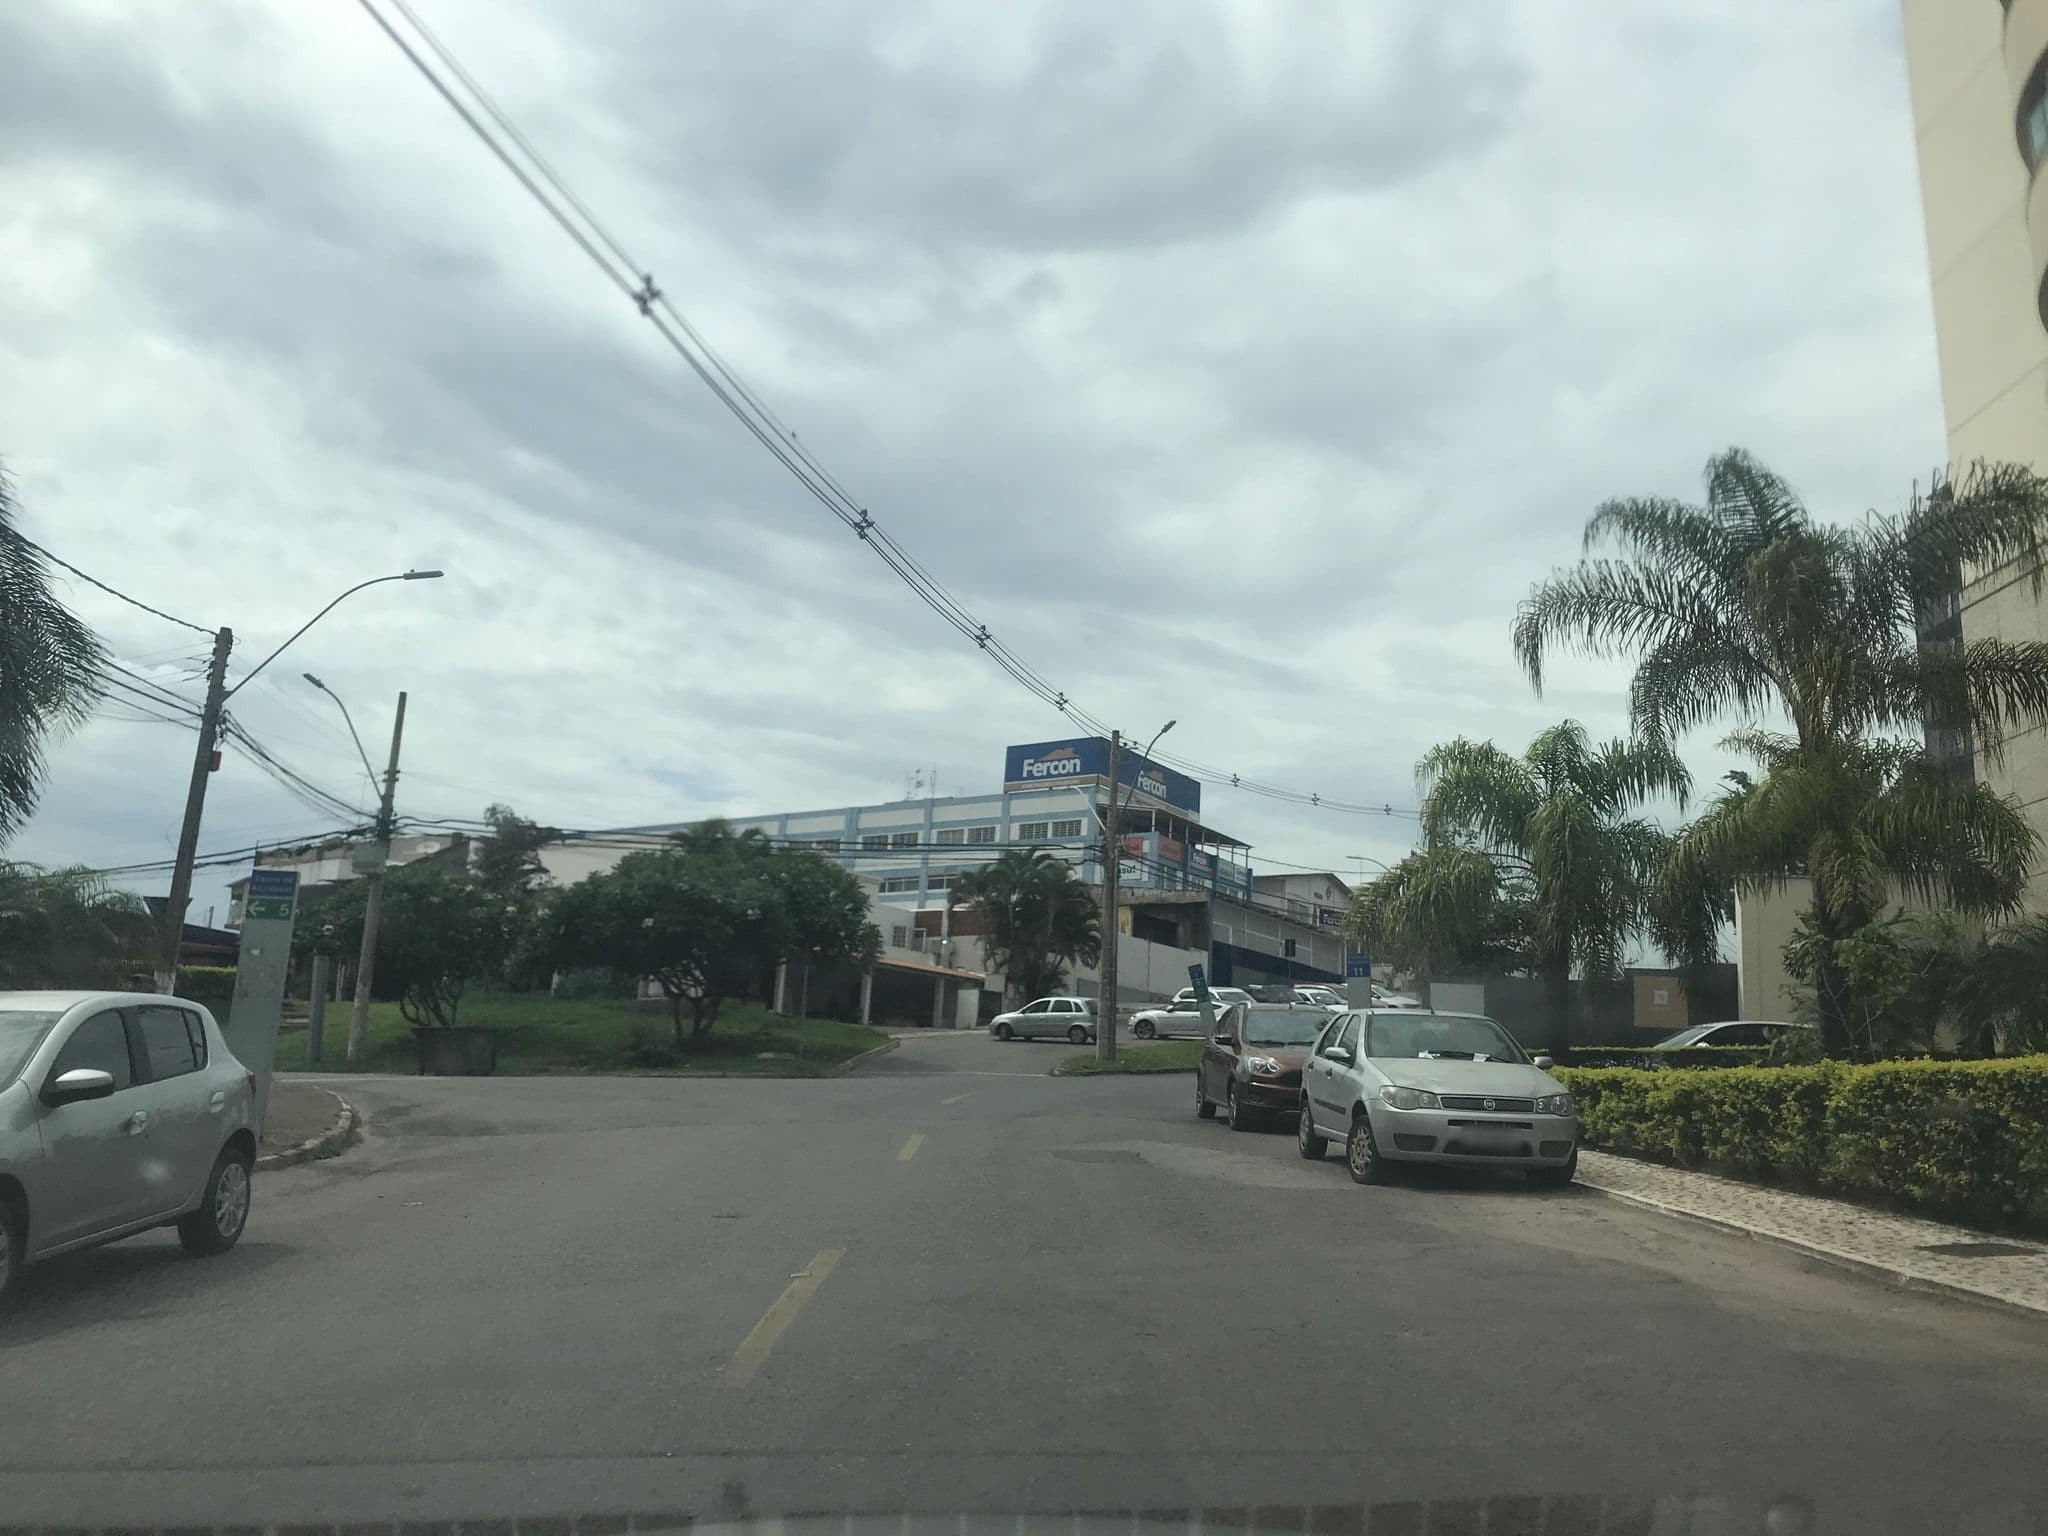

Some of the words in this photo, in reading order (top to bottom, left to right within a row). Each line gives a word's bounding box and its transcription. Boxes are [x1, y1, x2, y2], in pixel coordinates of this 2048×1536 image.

[1022, 757, 1081, 778] Fercon
[1137, 770, 1167, 799] Fercon
[279, 904, 290, 917] 5
[1353, 968, 1364, 976] 11
